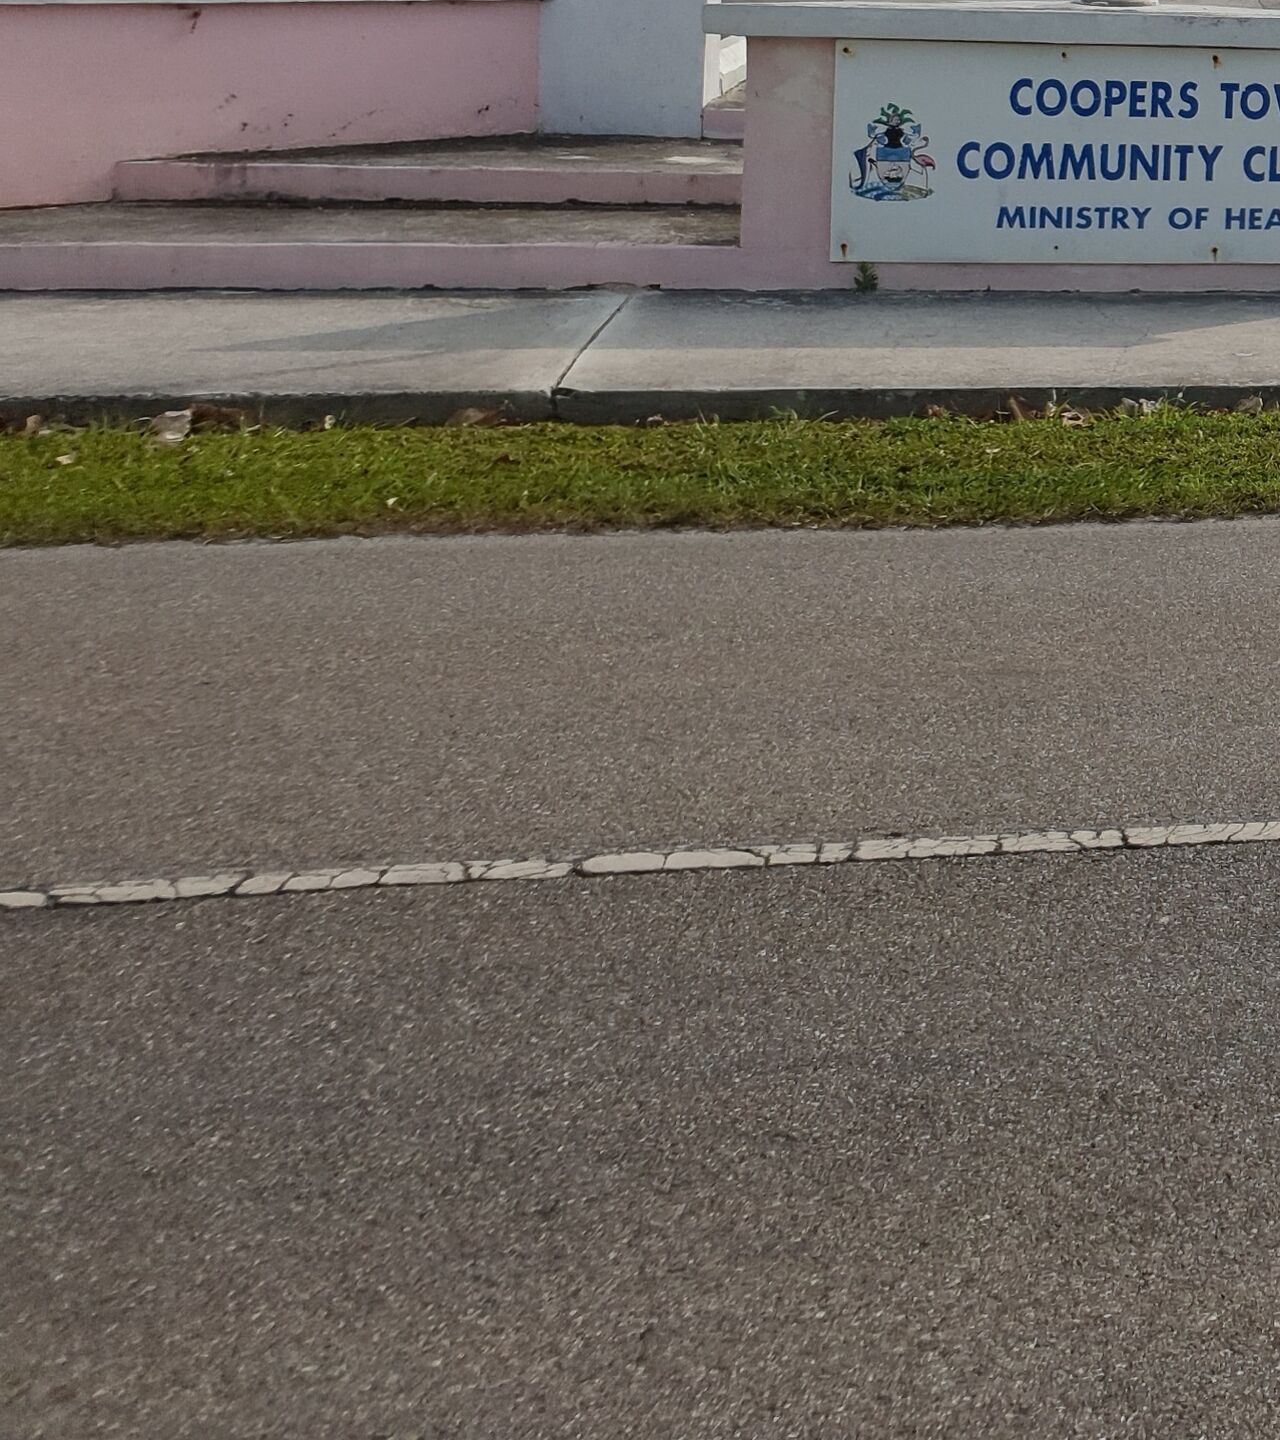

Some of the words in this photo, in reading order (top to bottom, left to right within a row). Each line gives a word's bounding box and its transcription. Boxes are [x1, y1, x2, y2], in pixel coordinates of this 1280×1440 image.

[1009, 78, 1199, 118] COOPERS
[956, 141, 1224, 182] COMMUNITY
[995, 206, 1152, 230] MINISTRY
[1167, 207, 1209, 230] OF
